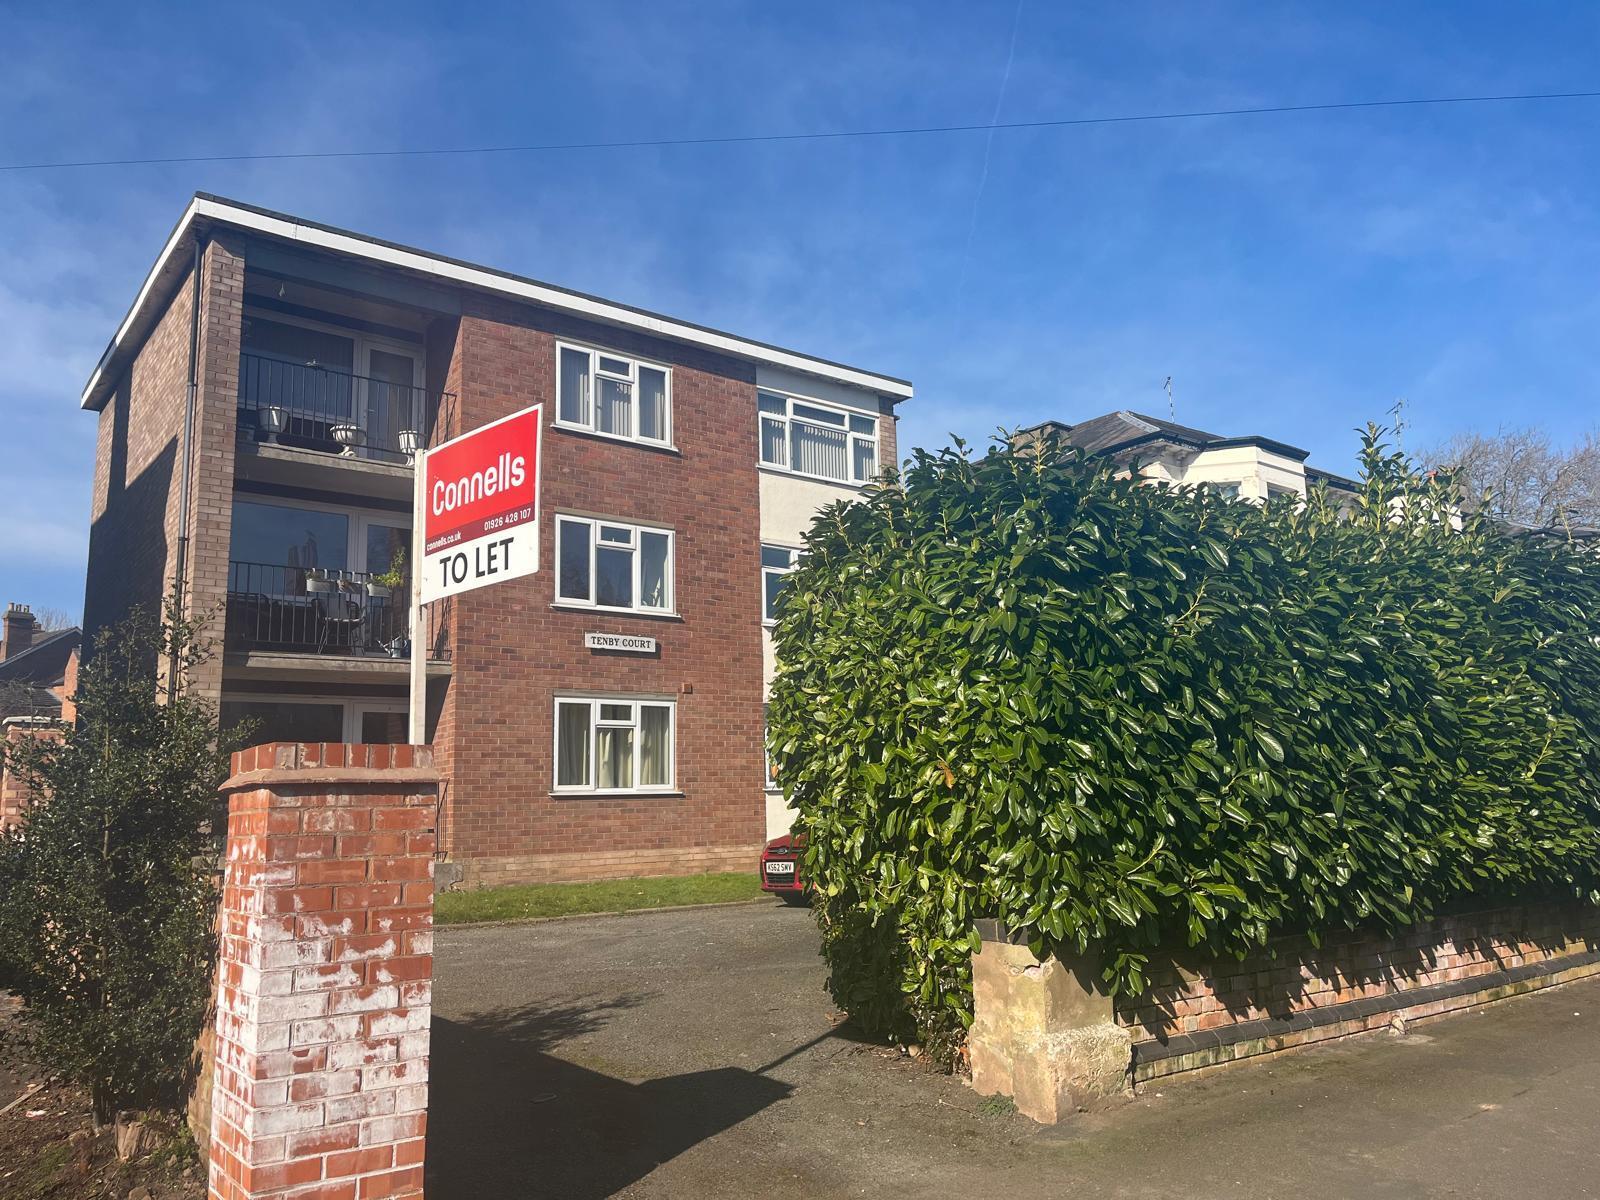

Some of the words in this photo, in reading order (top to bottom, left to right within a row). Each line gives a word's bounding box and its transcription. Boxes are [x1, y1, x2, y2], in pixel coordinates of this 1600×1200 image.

[433, 452, 525, 516] Connells
[484, 517, 503, 531] 01926
[505, 511, 518, 524] 428
[520, 508, 531, 520] 107
[426, 531, 462, 551] connells.co.uk
[440, 552, 468, 587] TO
[475, 537, 514, 578] LET
[591, 636, 619, 646] TENBY
[622, 639, 651, 648] COURT
